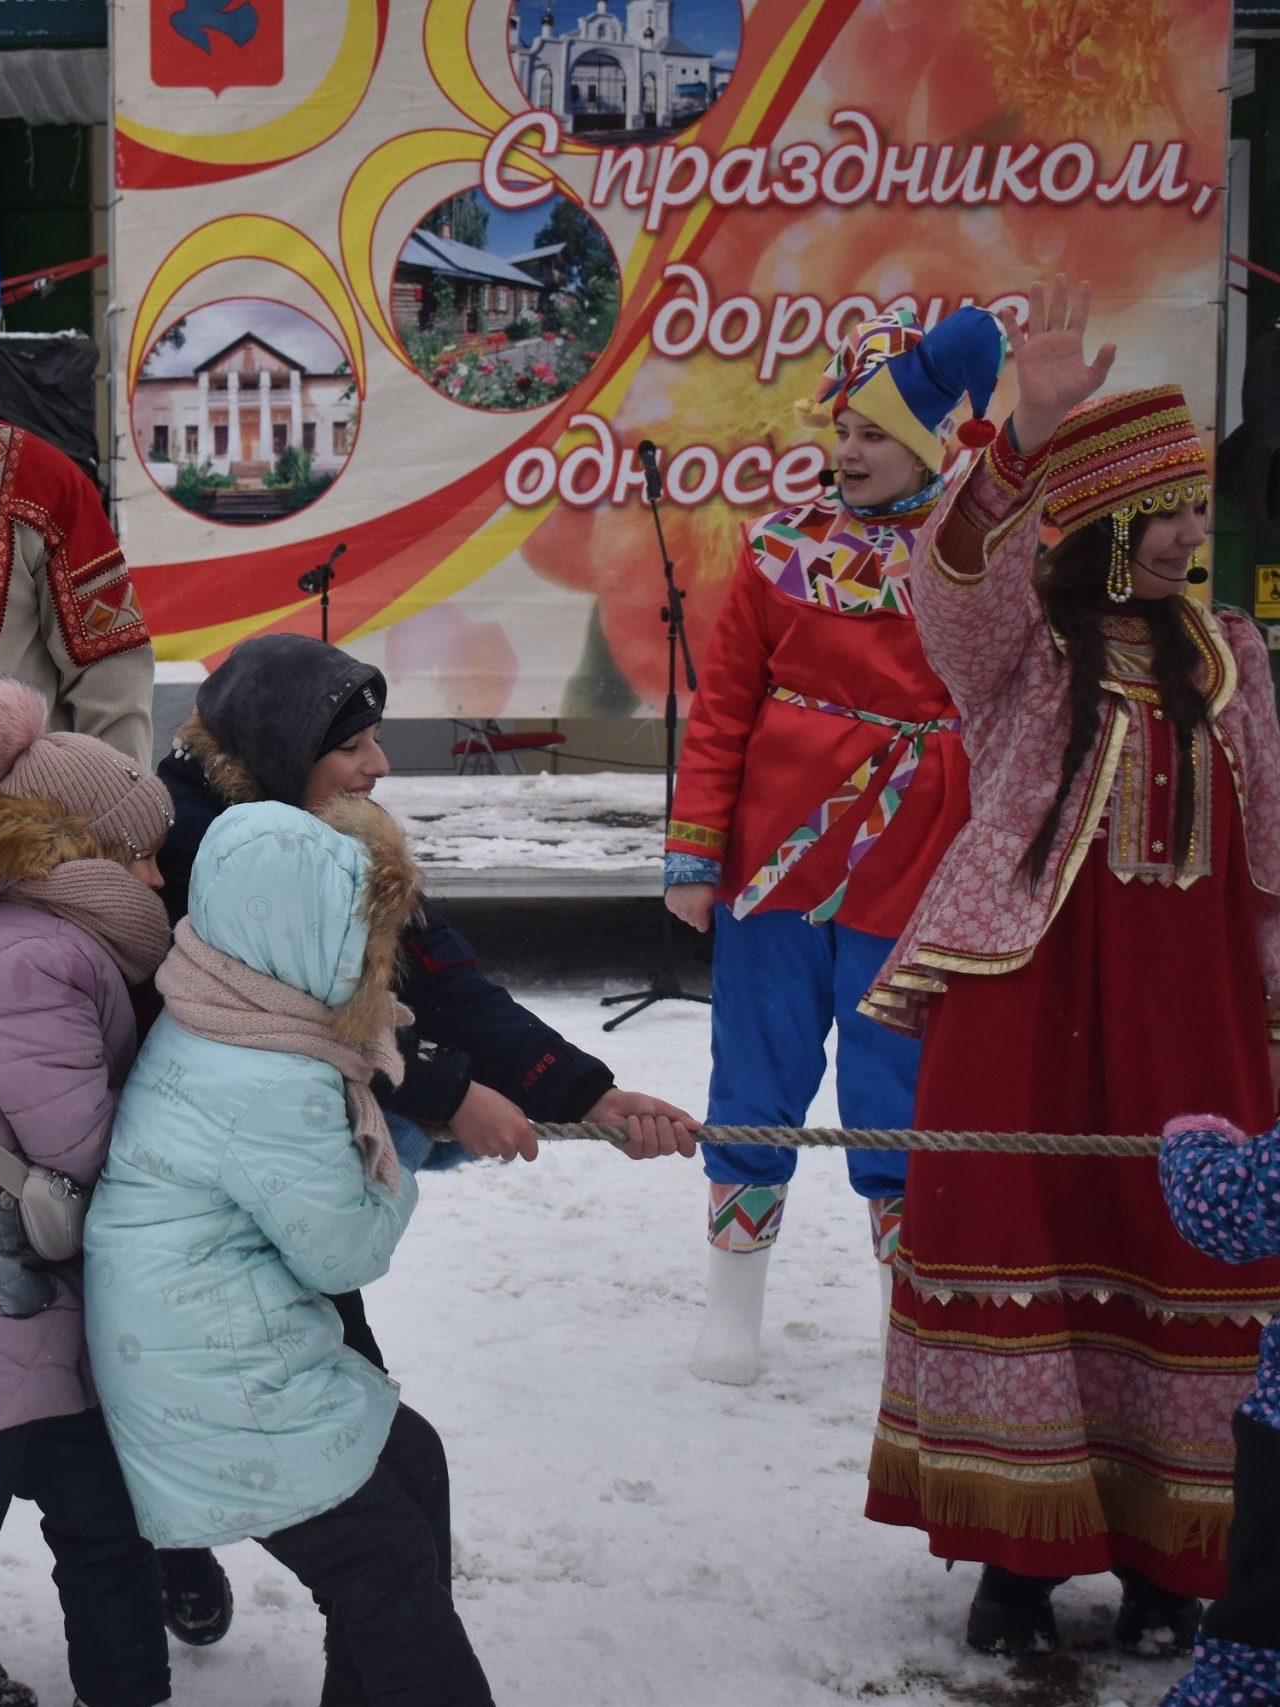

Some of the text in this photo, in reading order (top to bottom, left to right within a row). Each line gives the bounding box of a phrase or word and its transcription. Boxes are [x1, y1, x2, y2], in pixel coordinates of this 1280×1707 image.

[483, 109, 1214, 232] С праздником,
[651, 263, 1031, 380] доро
